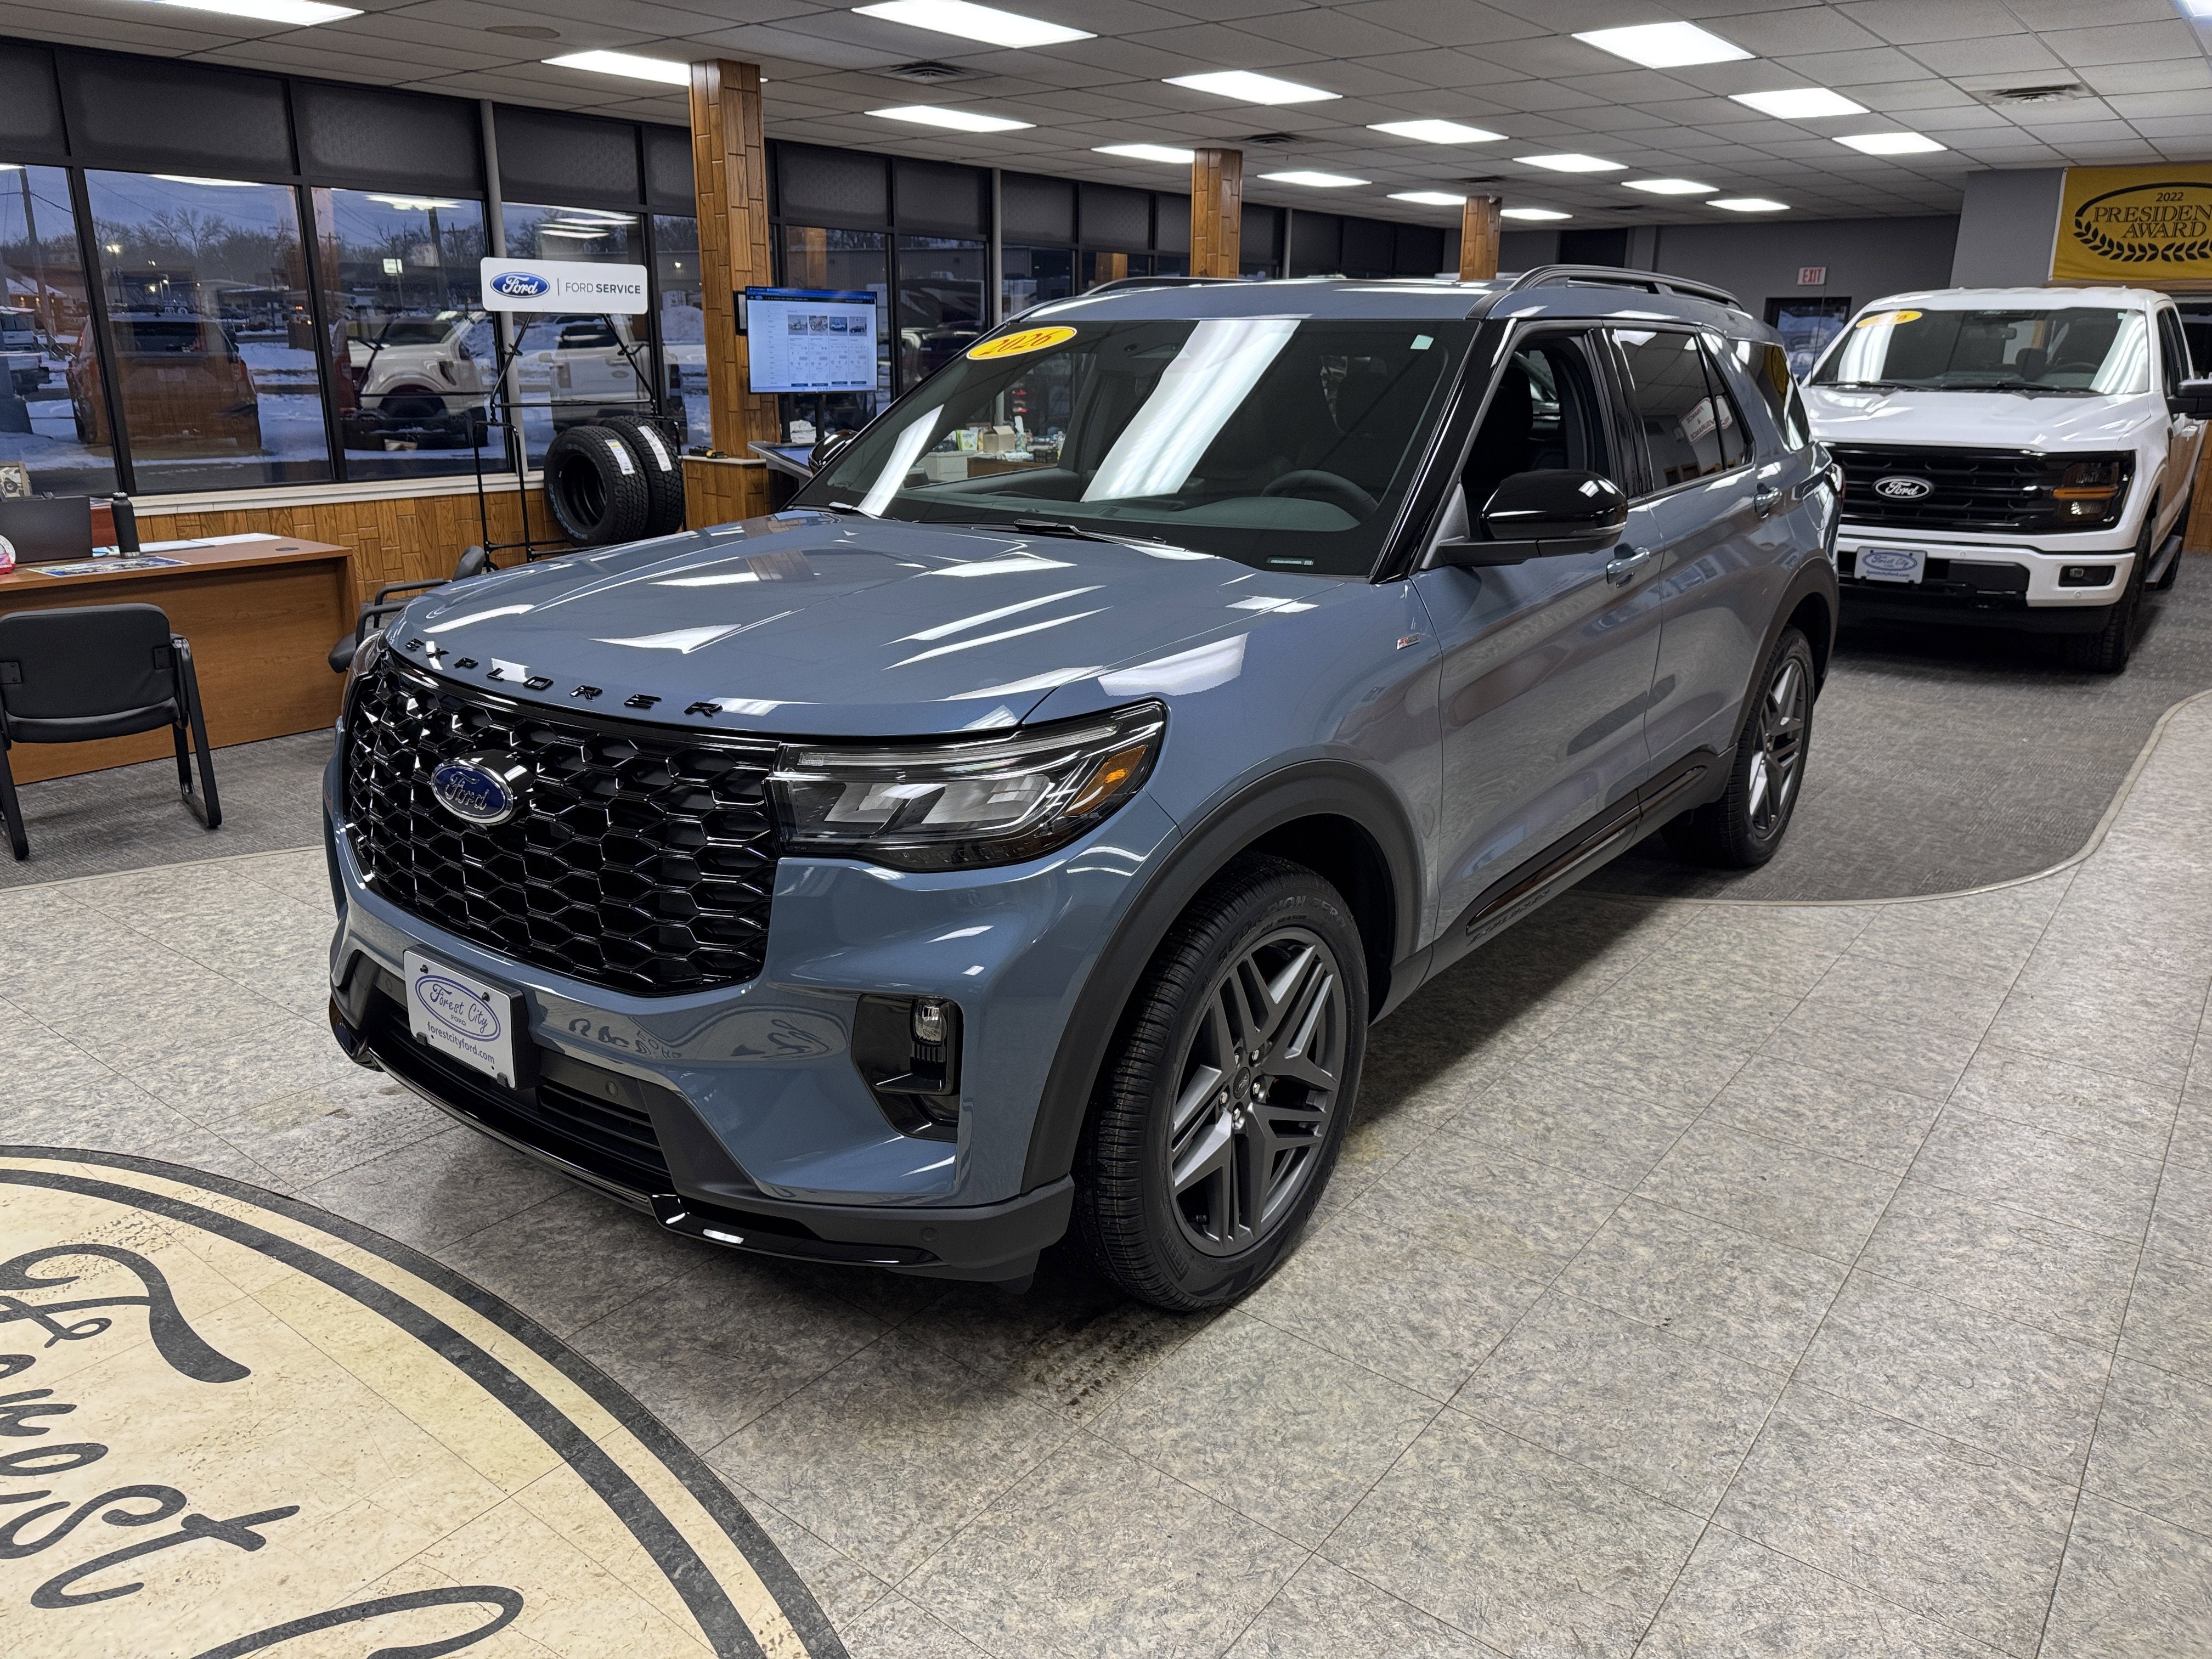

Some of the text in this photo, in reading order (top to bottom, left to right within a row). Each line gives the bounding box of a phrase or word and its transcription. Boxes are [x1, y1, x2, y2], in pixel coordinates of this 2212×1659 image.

[2155, 192, 2184, 202] 2022
[2121, 221, 2207, 238] AWARD
[502, 275, 538, 295] Ford
[1802, 269, 1822, 283] EXIT
[566, 282, 641, 295] FORD SERVICE
[978, 330, 1064, 356] 2026
[1885, 482, 1920, 496] Ford
[405, 638, 723, 717] EXPLORER
[444, 771, 490, 811] Ford
[430, 984, 488, 1034] Forest City
[451, 1014, 466, 1026] FORD
[427, 1022, 495, 1064] forestcityford.com
